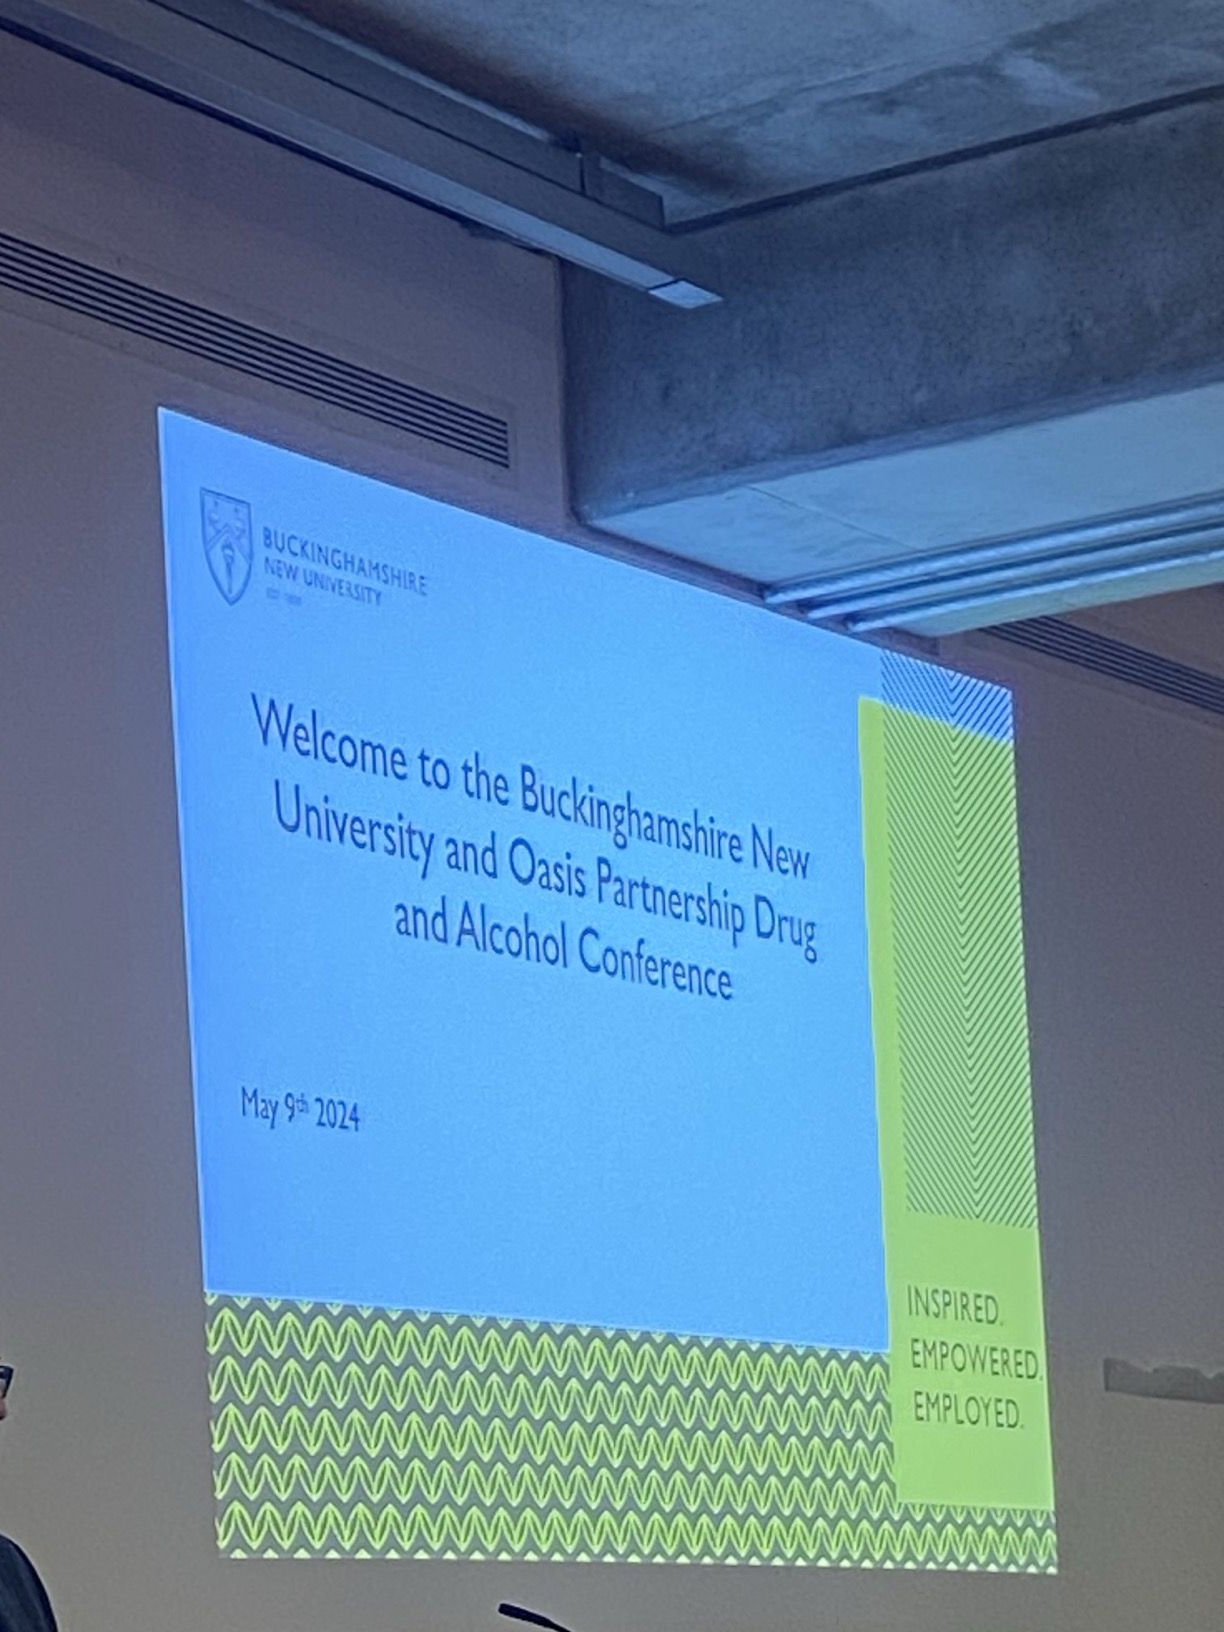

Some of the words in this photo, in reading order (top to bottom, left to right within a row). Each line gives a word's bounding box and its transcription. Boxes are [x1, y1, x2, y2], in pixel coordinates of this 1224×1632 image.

[262, 525, 428, 597] BUCKINGHAMSHIRE
[264, 556, 299, 583] NEW
[303, 569, 383, 607] UNIVERSITY
[250, 692, 408, 780] Welcome
[418, 748, 451, 790] to
[462, 751, 510, 806] the
[521, 763, 744, 864] Buckinghamshire
[752, 824, 811, 880] New
[275, 779, 435, 880] University
[447, 832, 497, 879] and
[509, 837, 586, 898] Oasis
[596, 856, 745, 948] Partnership
[755, 895, 818, 964] Drug
[394, 896, 448, 944] and
[457, 901, 568, 968] Alcohol
[579, 927, 734, 1001] Conference
[241, 1086, 279, 1130] May
[315, 1097, 361, 1132] 2024
[907, 1284, 1004, 1327] INSPIRED.
[911, 1337, 1044, 1381] EMPOWERED.
[914, 1390, 1025, 1429] EMPLOYED.
